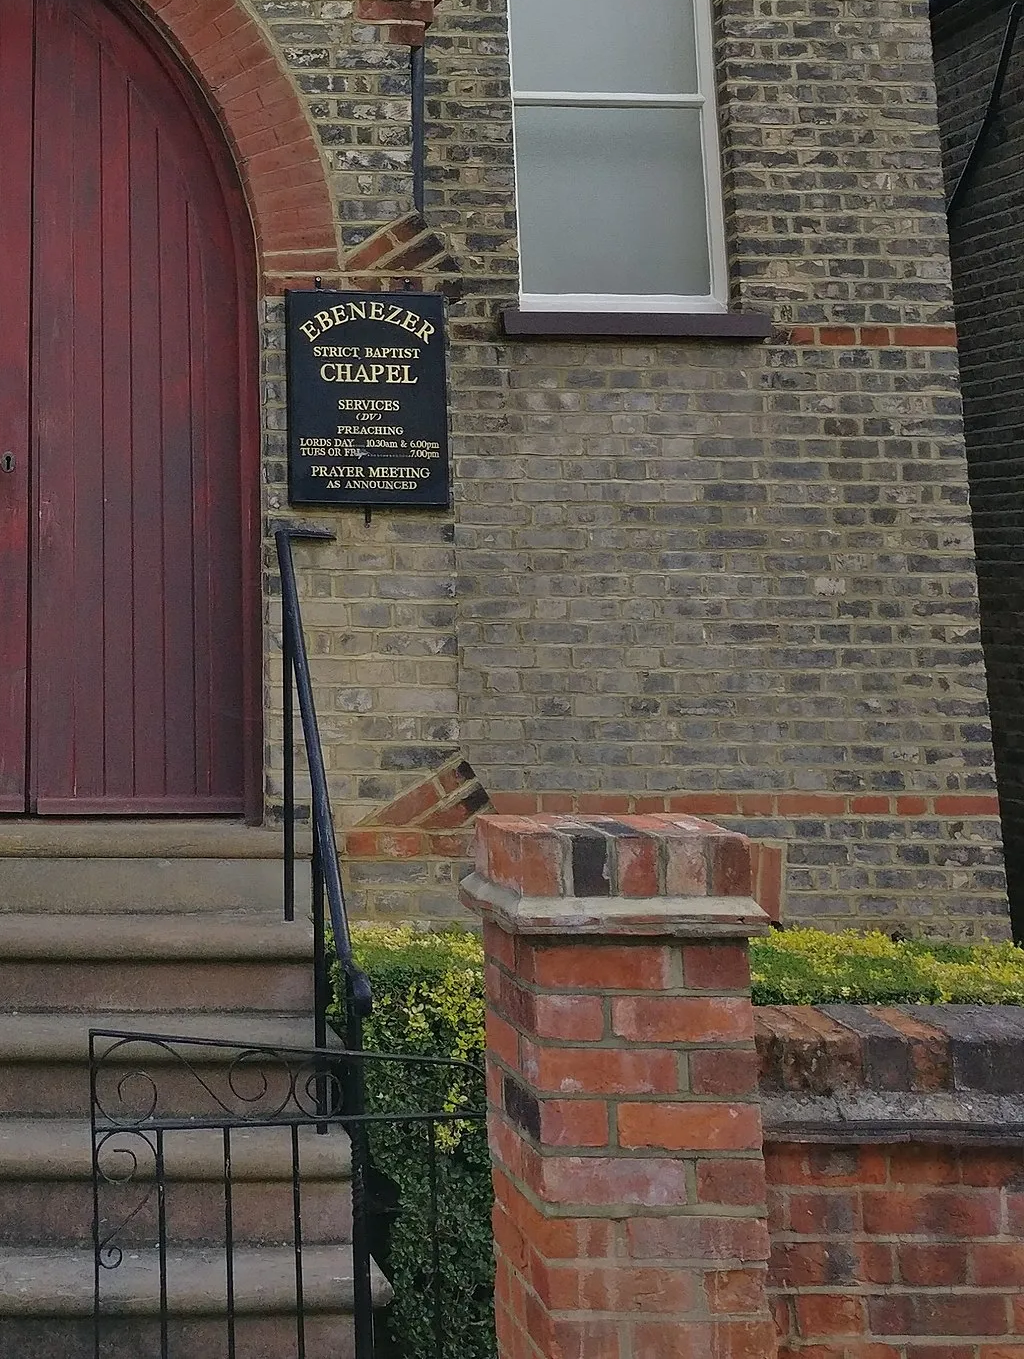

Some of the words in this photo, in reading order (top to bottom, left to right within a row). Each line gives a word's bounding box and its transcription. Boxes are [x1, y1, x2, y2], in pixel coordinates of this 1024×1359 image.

[299, 301, 436, 344] EBENEZER
[313, 346, 360, 357] STRICT
[365, 348, 420, 359] BAPTIST
[320, 363, 418, 384] CHAPEL
[338, 400, 400, 411] SERVICES
[356, 413, 382, 421] (DV)
[337, 426, 403, 435] PREACHING
[300, 438, 331, 447] LORDS
[366, 440, 398, 448] 10.30am
[401, 440, 407, 448] &
[410, 441, 439, 449] 6.00pm
[300, 448, 327, 456] TUES
[329, 448, 341, 456] OR
[311, 466, 364, 477] PRAYER
[369, 467, 430, 478] MEETING
[327, 480, 340, 488] AS
[345, 481, 417, 490] ANNOUNCED
